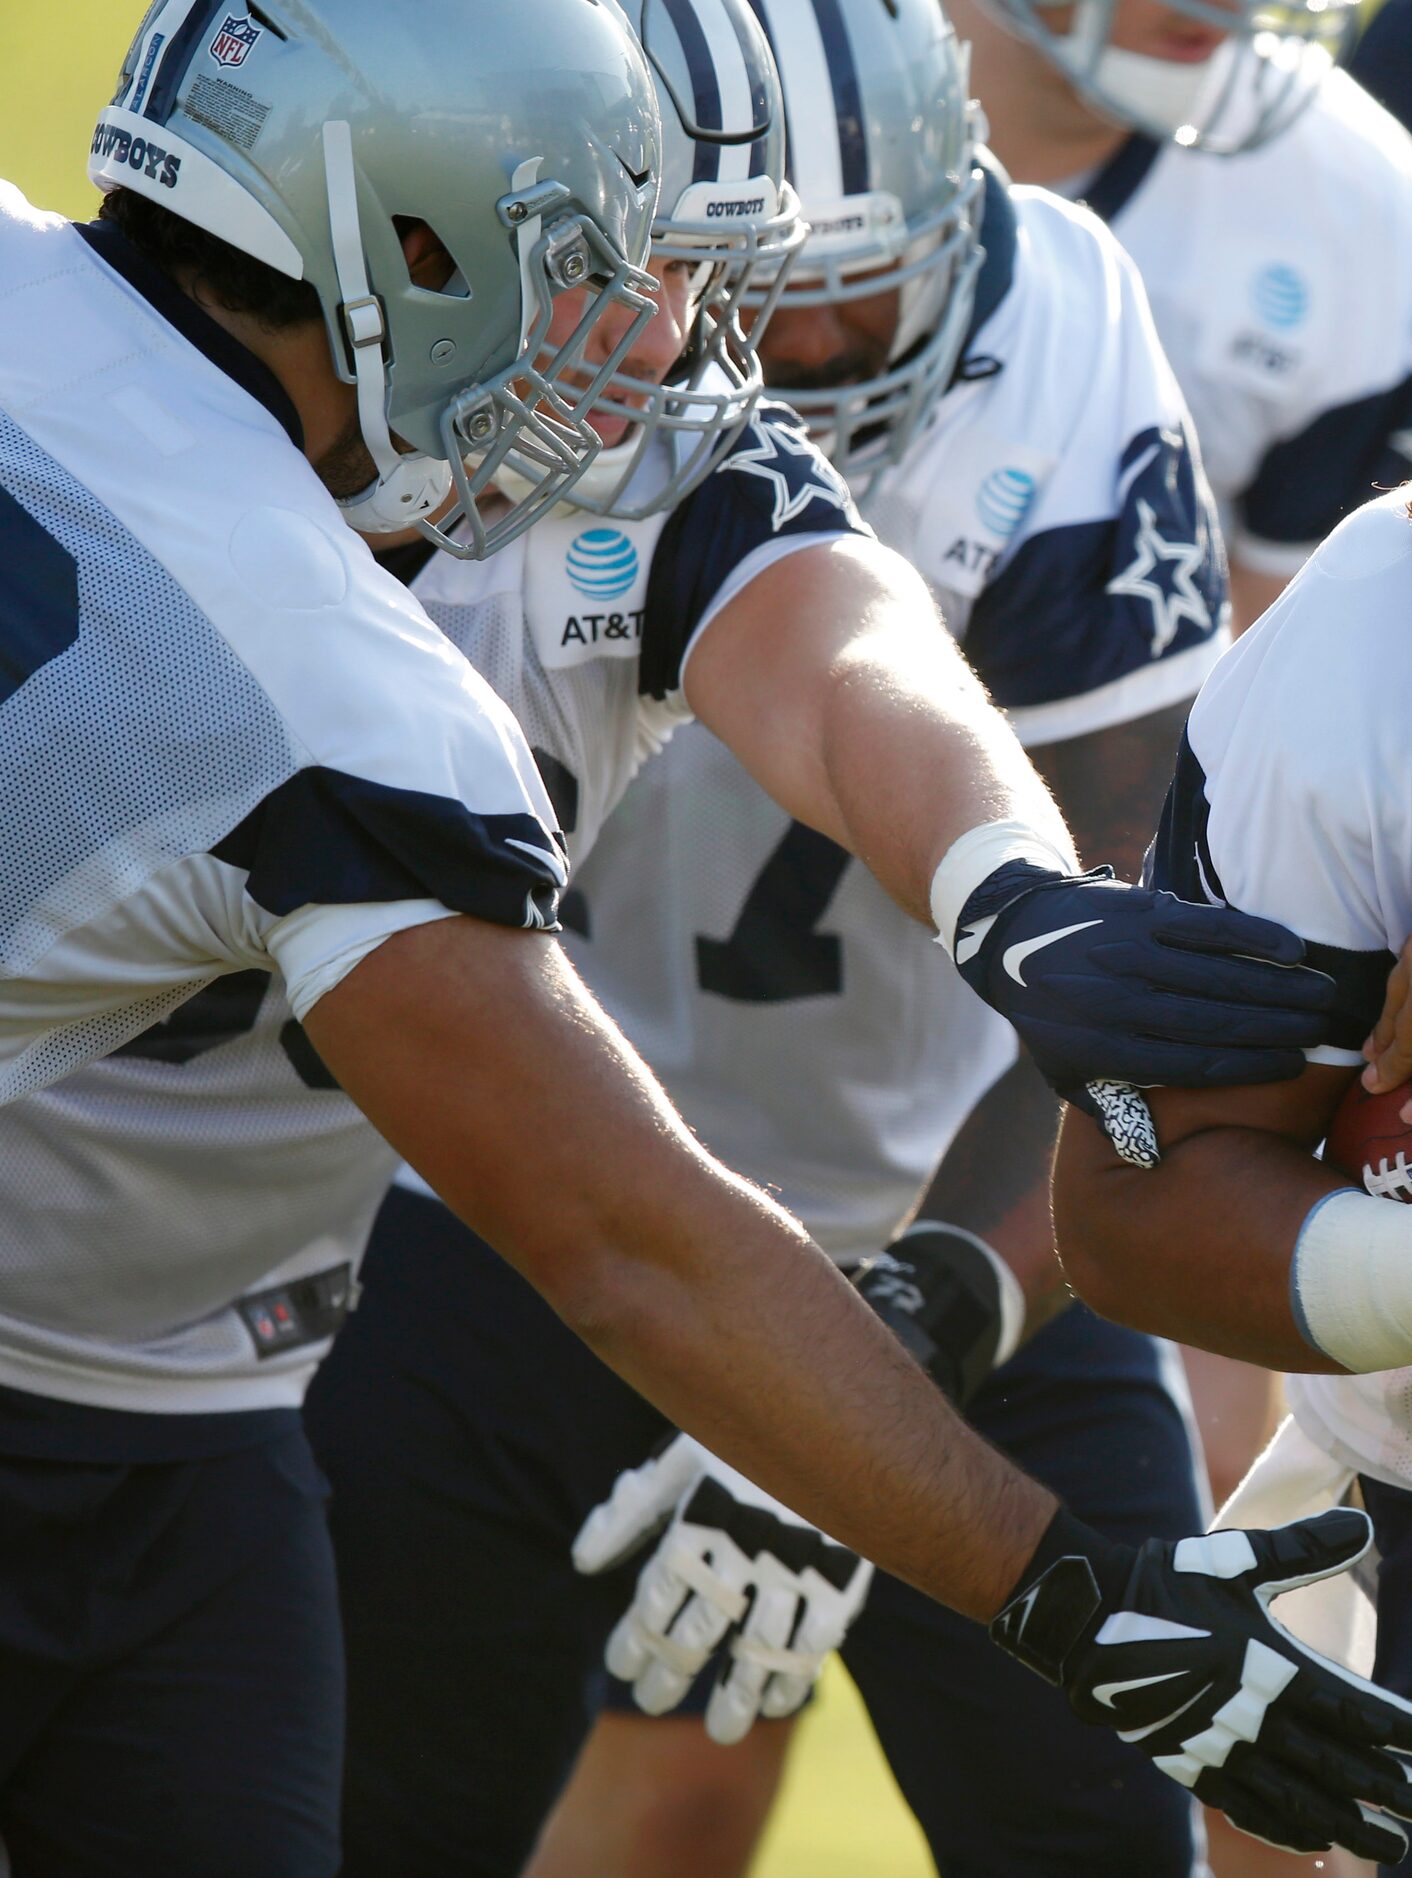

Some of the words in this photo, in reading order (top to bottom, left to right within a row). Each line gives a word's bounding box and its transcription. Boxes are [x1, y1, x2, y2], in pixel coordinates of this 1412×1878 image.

[213, 33, 245, 63] NFL
[216, 78, 253, 99] WARNING
[706, 198, 765, 217] COWBOYS
[561, 609, 647, 646] AT&T
